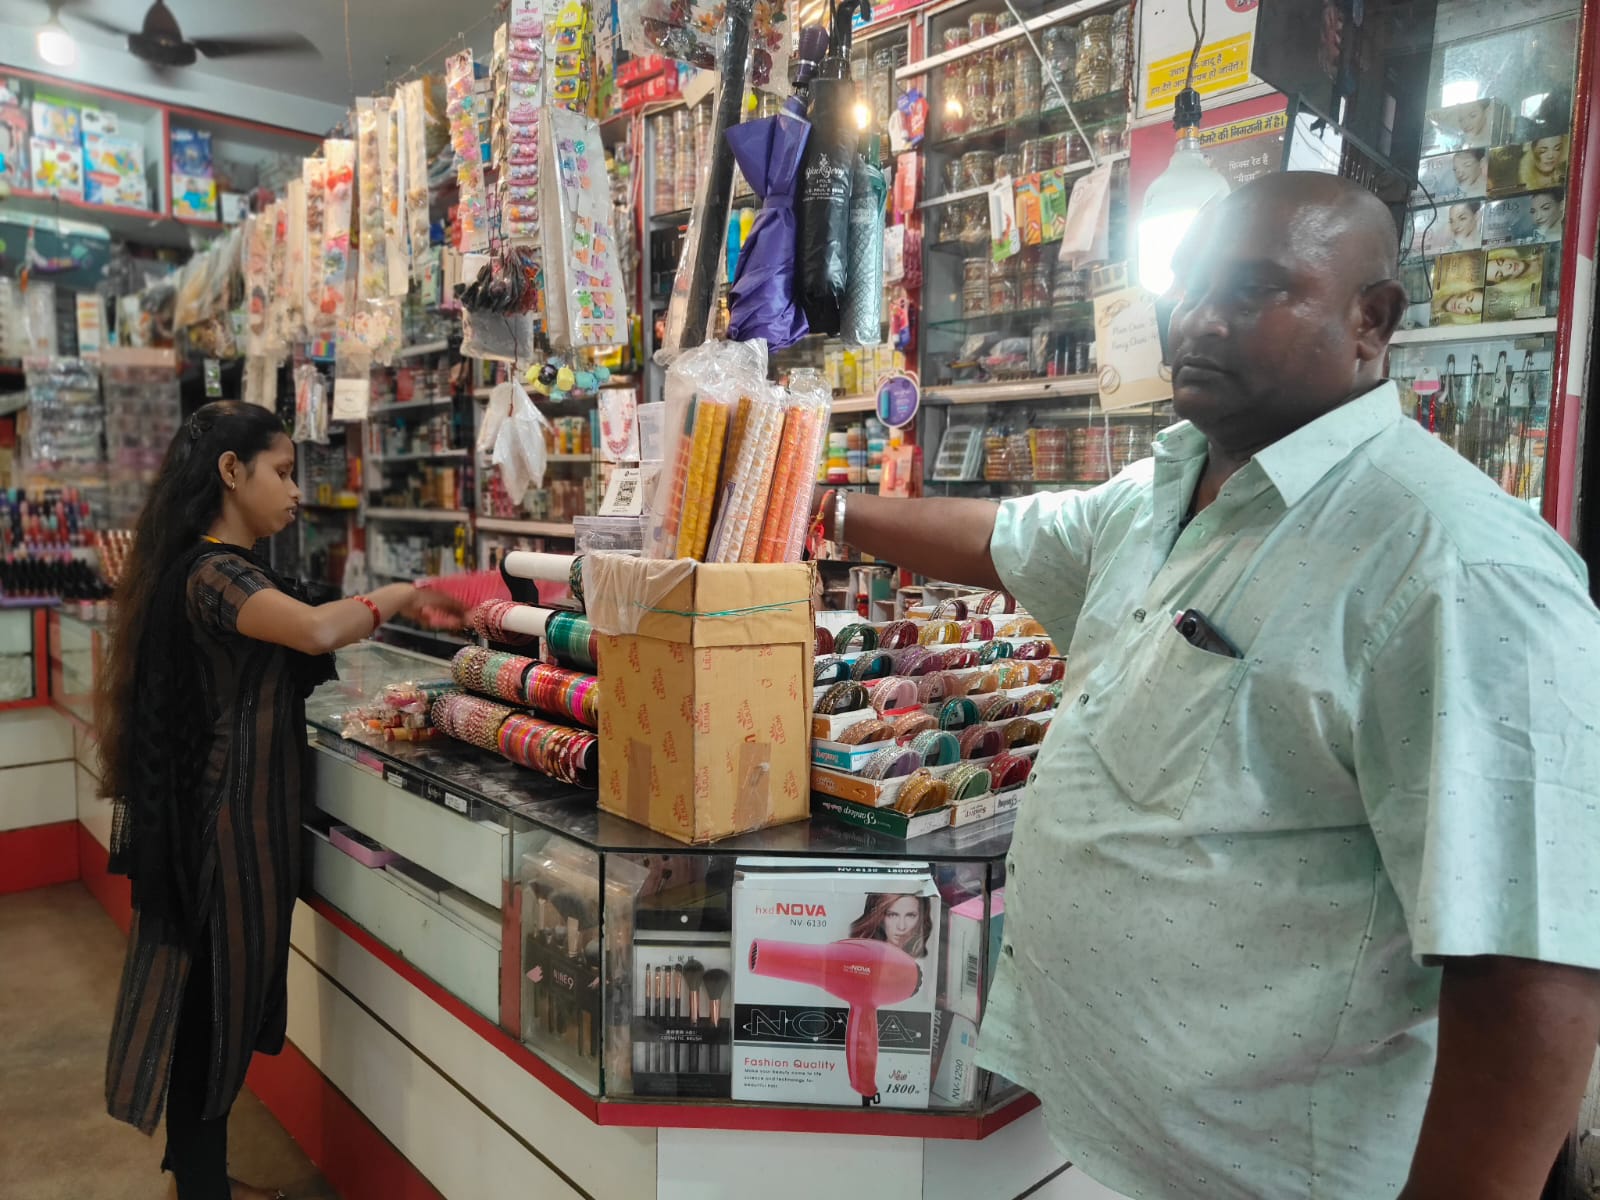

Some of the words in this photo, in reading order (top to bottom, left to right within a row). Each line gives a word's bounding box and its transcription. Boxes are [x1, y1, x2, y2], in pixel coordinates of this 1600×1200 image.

[1217, 127, 1229, 140] की
[1264, 115, 1272, 129] में
[701, 702, 710, 735] LILIUM
[699, 766, 709, 799] LILIUM
[806, 919, 827, 928] 6130
[750, 1008, 915, 1043] NOA
[744, 1057, 789, 1068] Fashion
[793, 1059, 836, 1072] Quality
[952, 1058, 964, 1100] NV-1290
